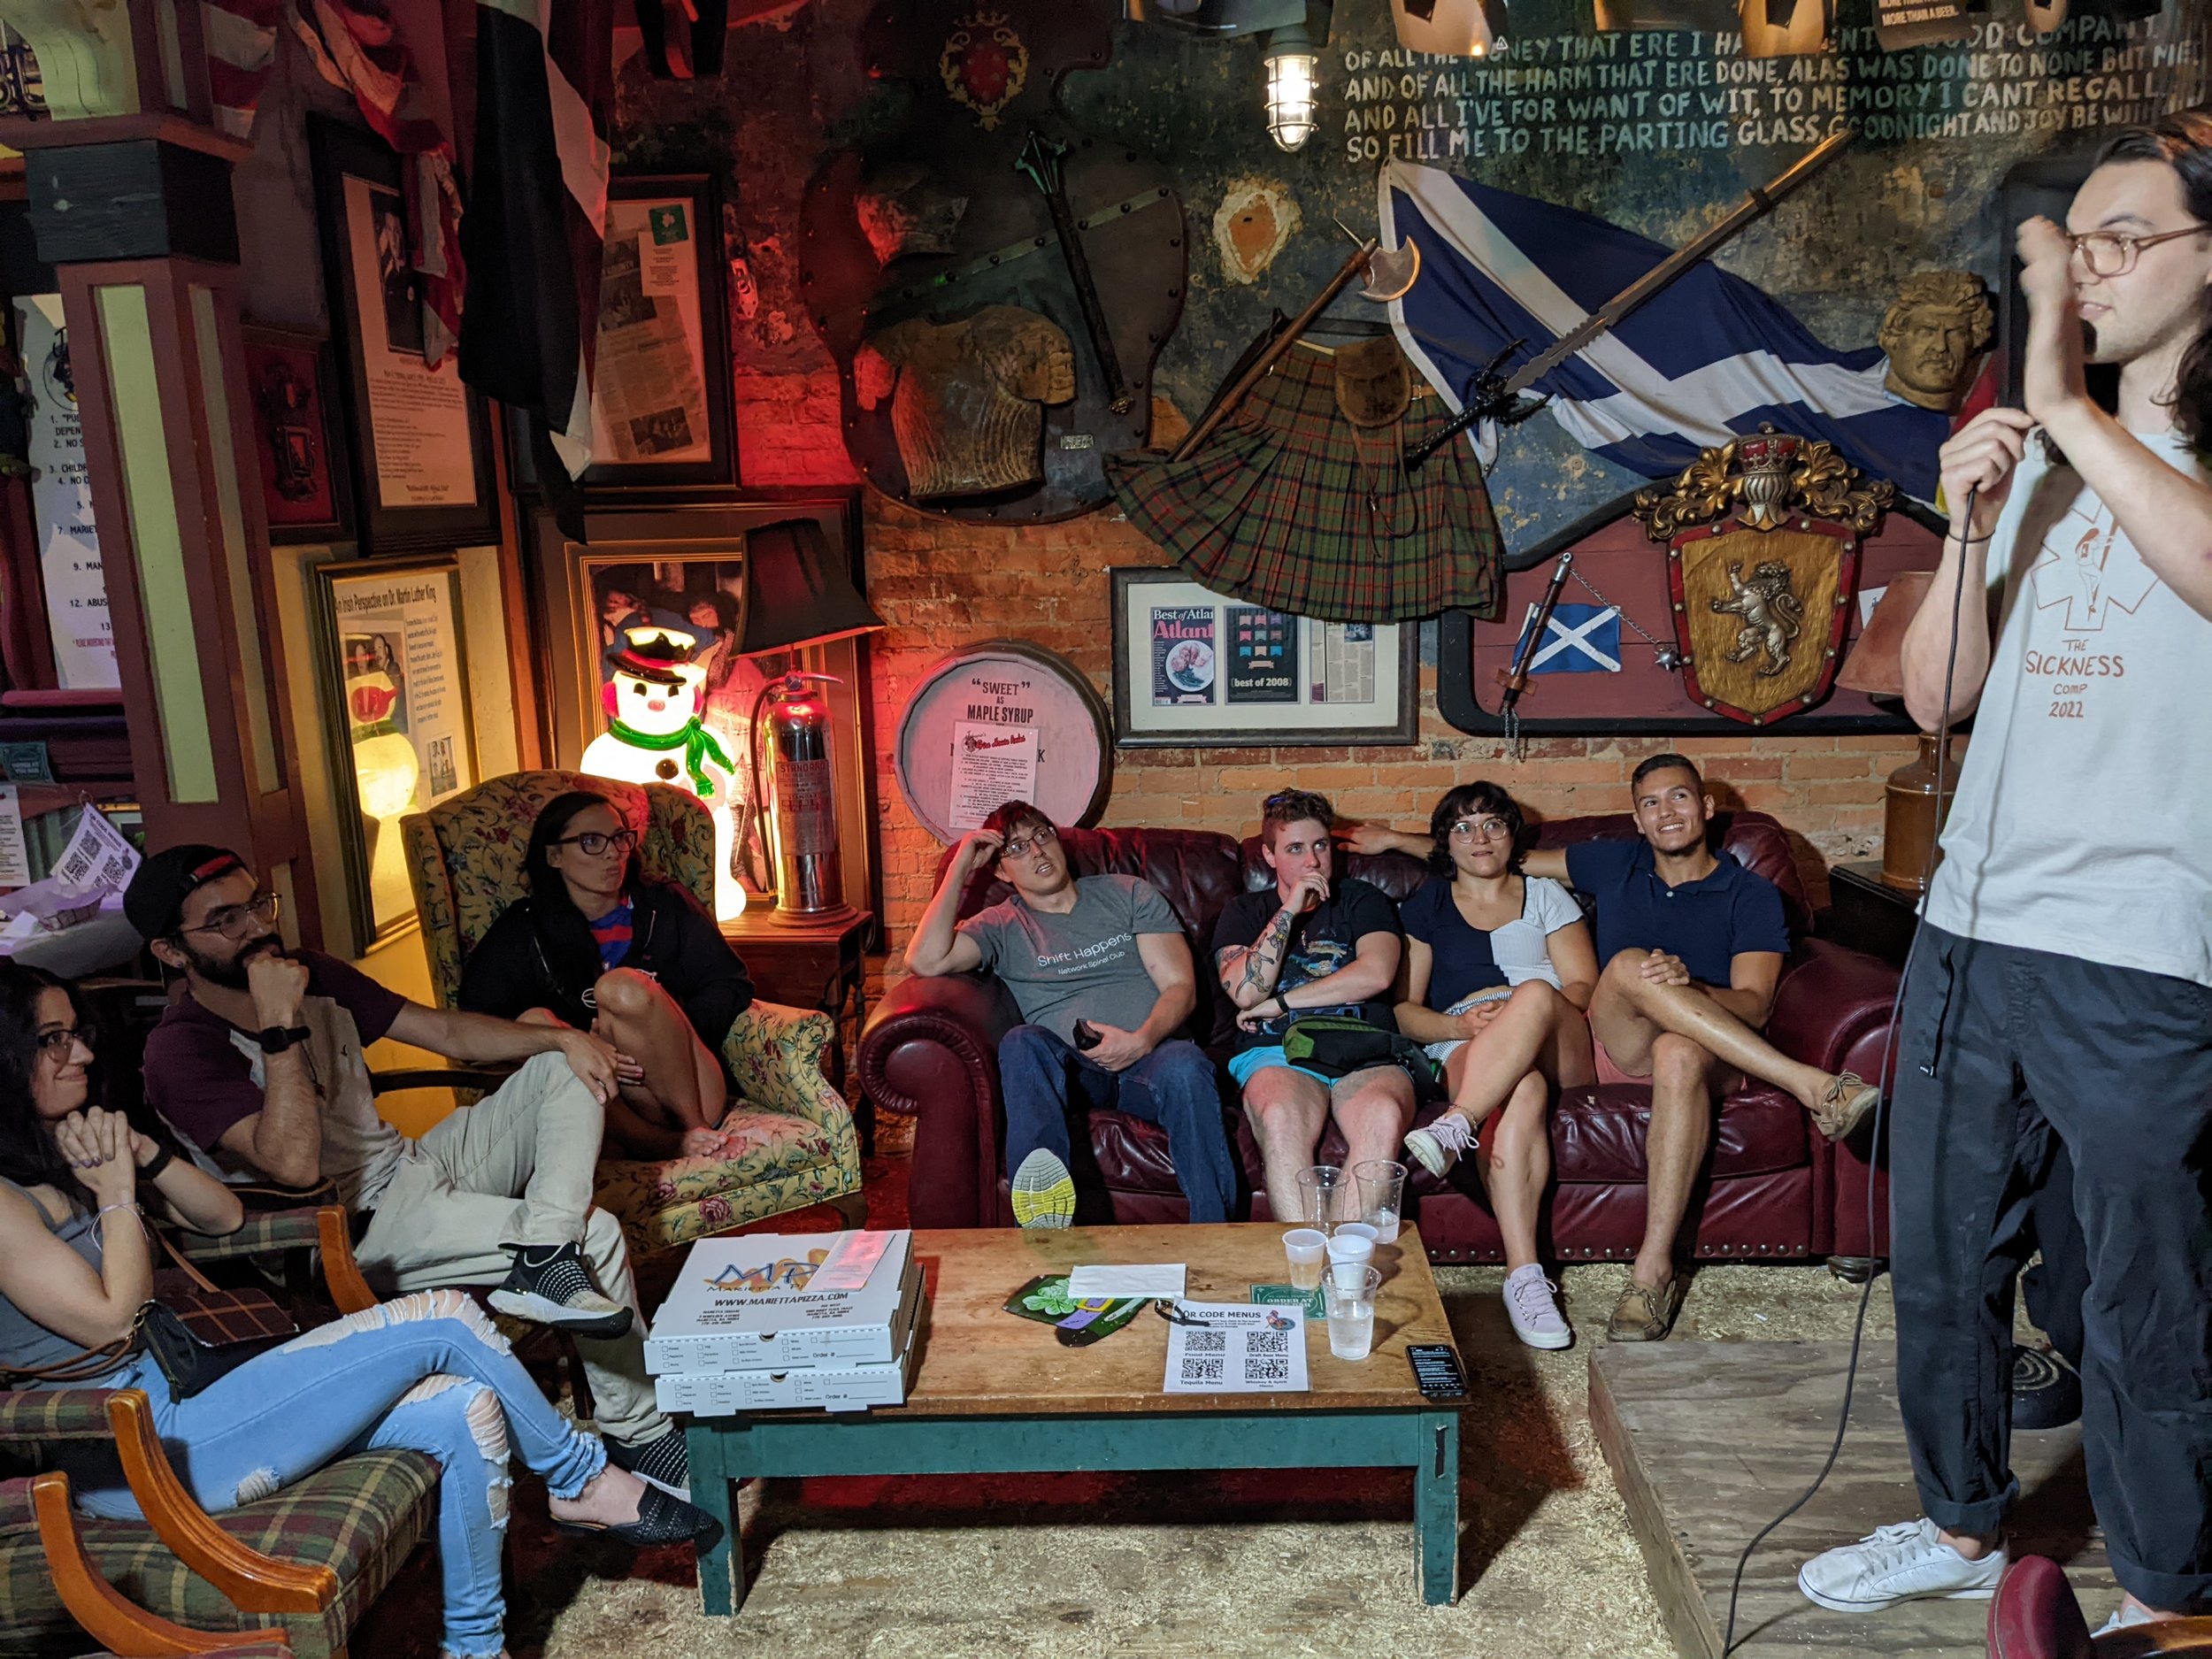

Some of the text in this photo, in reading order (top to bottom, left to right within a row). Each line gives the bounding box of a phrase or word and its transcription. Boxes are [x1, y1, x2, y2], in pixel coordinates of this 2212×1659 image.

[1345, 50, 1371, 71] OF
[1379, 49, 1416, 68] ALL
[1556, 33, 1621, 60] THAT
[1630, 32, 1678, 58] ERE
[1691, 31, 1703, 57] I
[1344, 76, 1396, 102] AND
[1400, 73, 1431, 99] OF
[1433, 73, 1472, 97] ALL
[1475, 68, 1518, 96] THE
[1525, 65, 1593, 93] HARM
[1596, 59, 1658, 88] THAT
[1666, 60, 1711, 88] ERE
[1787, 56, 1851, 83] ALAS
[1858, 54, 1916, 81] WAS
[1922, 50, 1990, 81] DONE
[1997, 53, 2024, 77] TO
[2029, 50, 2095, 77] NONE
[2101, 45, 2147, 73] BUT
[1344, 104, 1396, 133] AND
[1404, 102, 1450, 129] ALL
[1455, 98, 1505, 127] I'VE
[1511, 97, 1557, 125] FOR
[1567, 90, 1651, 120] WANT
[1657, 90, 1692, 118] OF
[1699, 88, 1761, 119] WIT,
[1769, 87, 1803, 113] TO
[1811, 81, 1932, 113] MEMORY
[1939, 81, 1952, 109] I
[1961, 80, 2039, 109] CANT
[1346, 134, 1380, 163] SO
[1387, 130, 1440, 159] FILL
[1448, 128, 1487, 158] ME
[1492, 127, 1531, 155] TO
[1539, 125, 1590, 155] THE
[1598, 119, 1729, 155] PARTING
[1973, 109, 2022, 134] AND
[2024, 104, 2069, 132] JOY
[2071, 104, 2099, 129] BE
[55, 426, 82, 436] DEPEN
[66, 439, 78, 448] NO
[70, 525, 96, 534] MARIET
[86, 561, 103, 571] MAN
[87, 598, 108, 607] ABUS
[354, 592, 381, 614] Perspective
[396, 588, 411, 604] Martin
[411, 586, 426, 603] Luther
[425, 584, 437, 603] King
[1154, 609, 1178, 620] Best
[1178, 611, 1187, 621] of
[2062, 638, 2089, 651] THE
[2025, 650, 2124, 678] SICKNESS
[1255, 678, 1265, 687] of
[995, 695, 1004, 704] AS
[967, 704, 1033, 724] MAPLE SYRUP
[2048, 700, 2084, 718] 2022
[1037, 932, 1133, 967] Shift Happens
[1057, 949, 1126, 976] Network Spinal Club
[715, 1293, 849, 1306] WWW.MARIETTAPIZZA.COM
